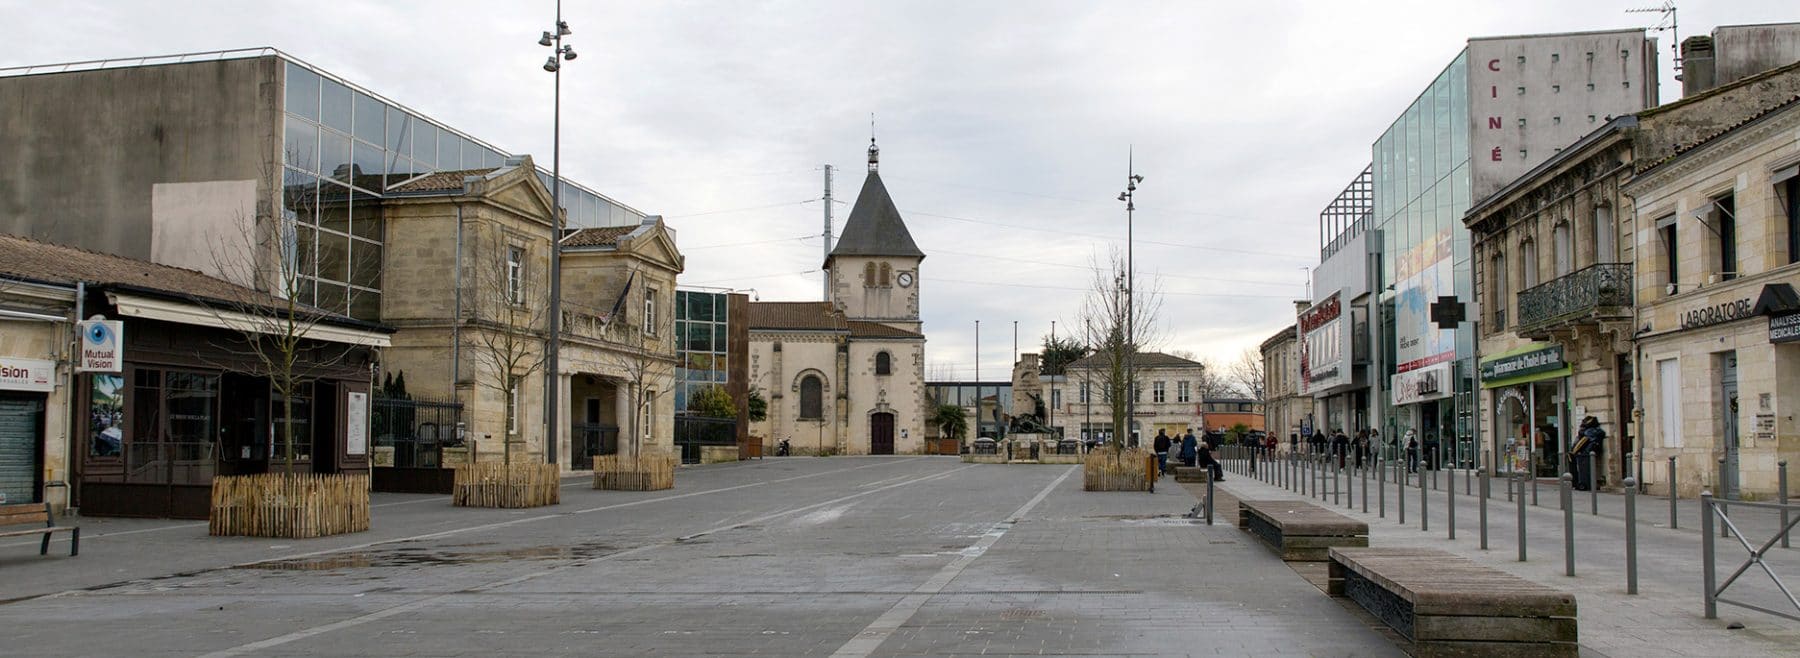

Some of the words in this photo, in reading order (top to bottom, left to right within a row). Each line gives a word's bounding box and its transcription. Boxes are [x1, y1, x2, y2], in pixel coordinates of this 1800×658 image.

[1488, 59, 1502, 161] CINÉ
[1680, 298, 1752, 330] LABORATOIRE
[84, 350, 115, 359] Mutual
[87, 360, 113, 369] Vision
